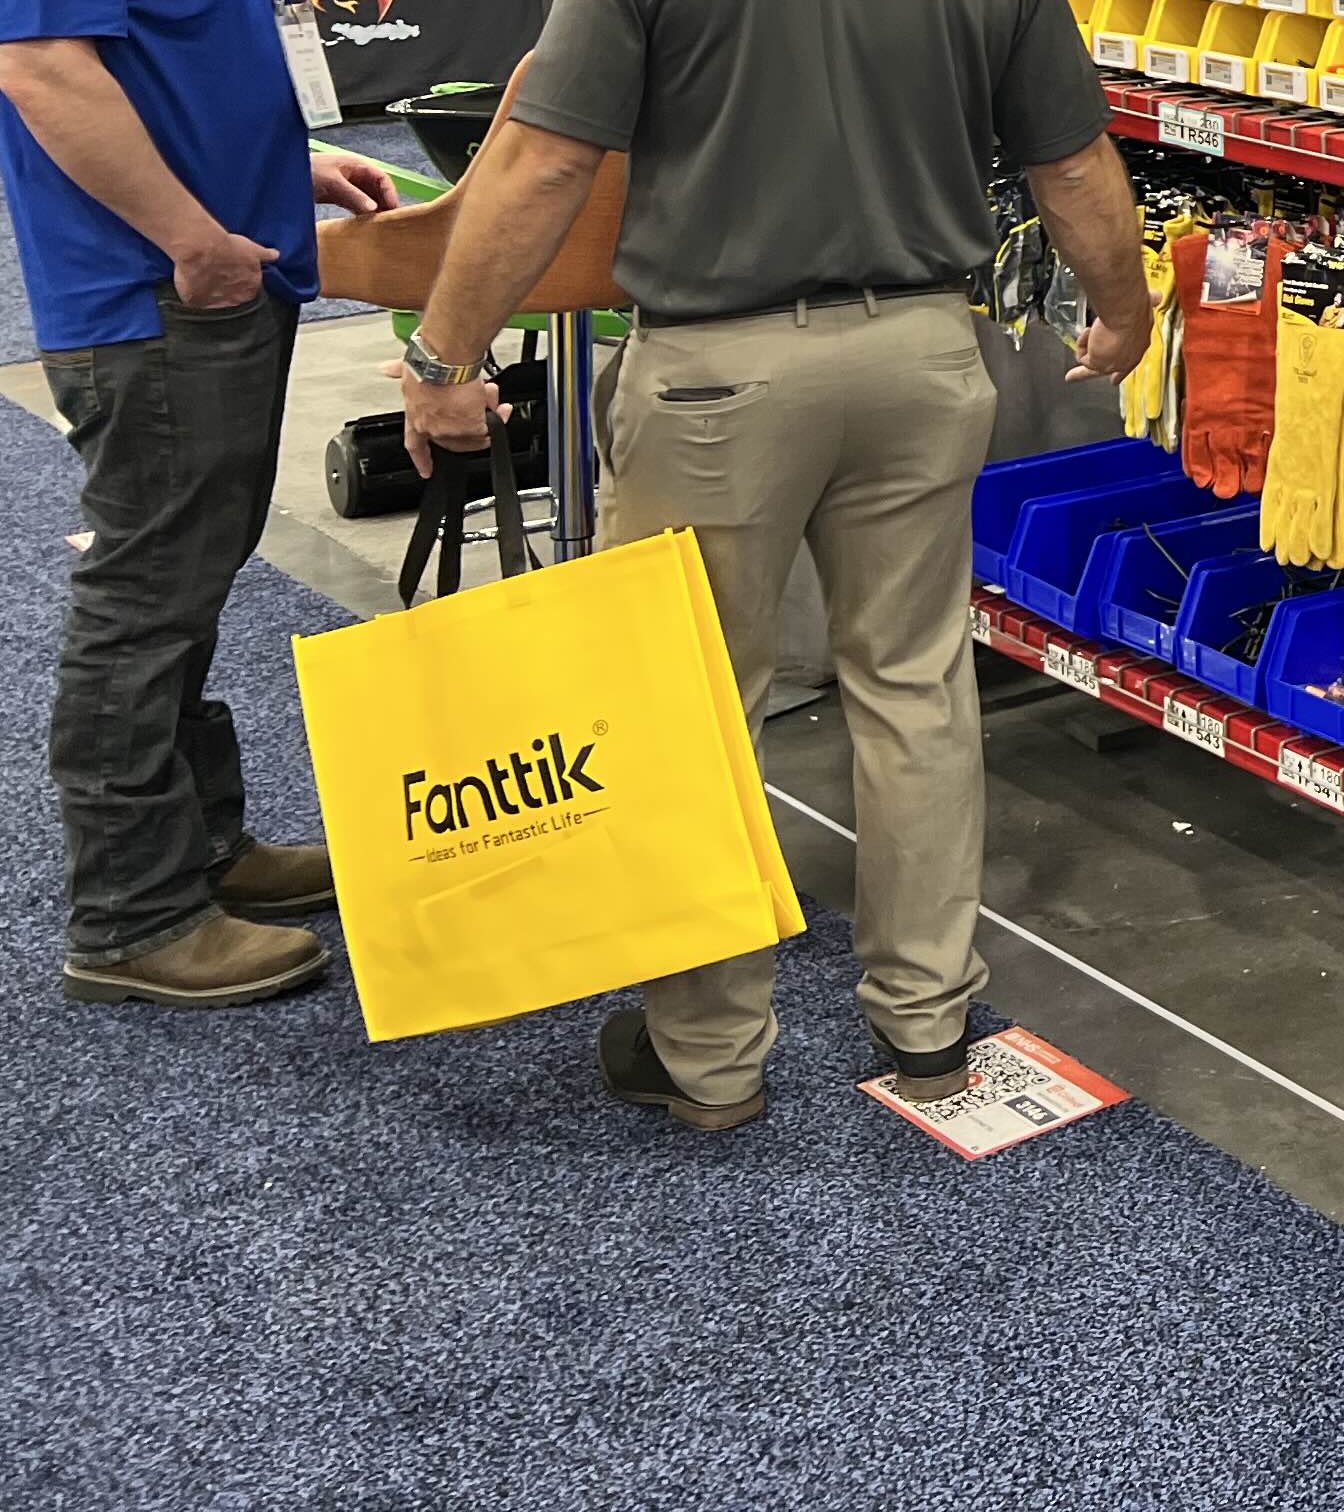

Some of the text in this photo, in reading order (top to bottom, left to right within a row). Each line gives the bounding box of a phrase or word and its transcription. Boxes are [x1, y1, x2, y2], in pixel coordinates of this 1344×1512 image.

[1188, 127, 1219, 148] R546
[424, 811, 584, 865] Ideas for Fantastic Life
